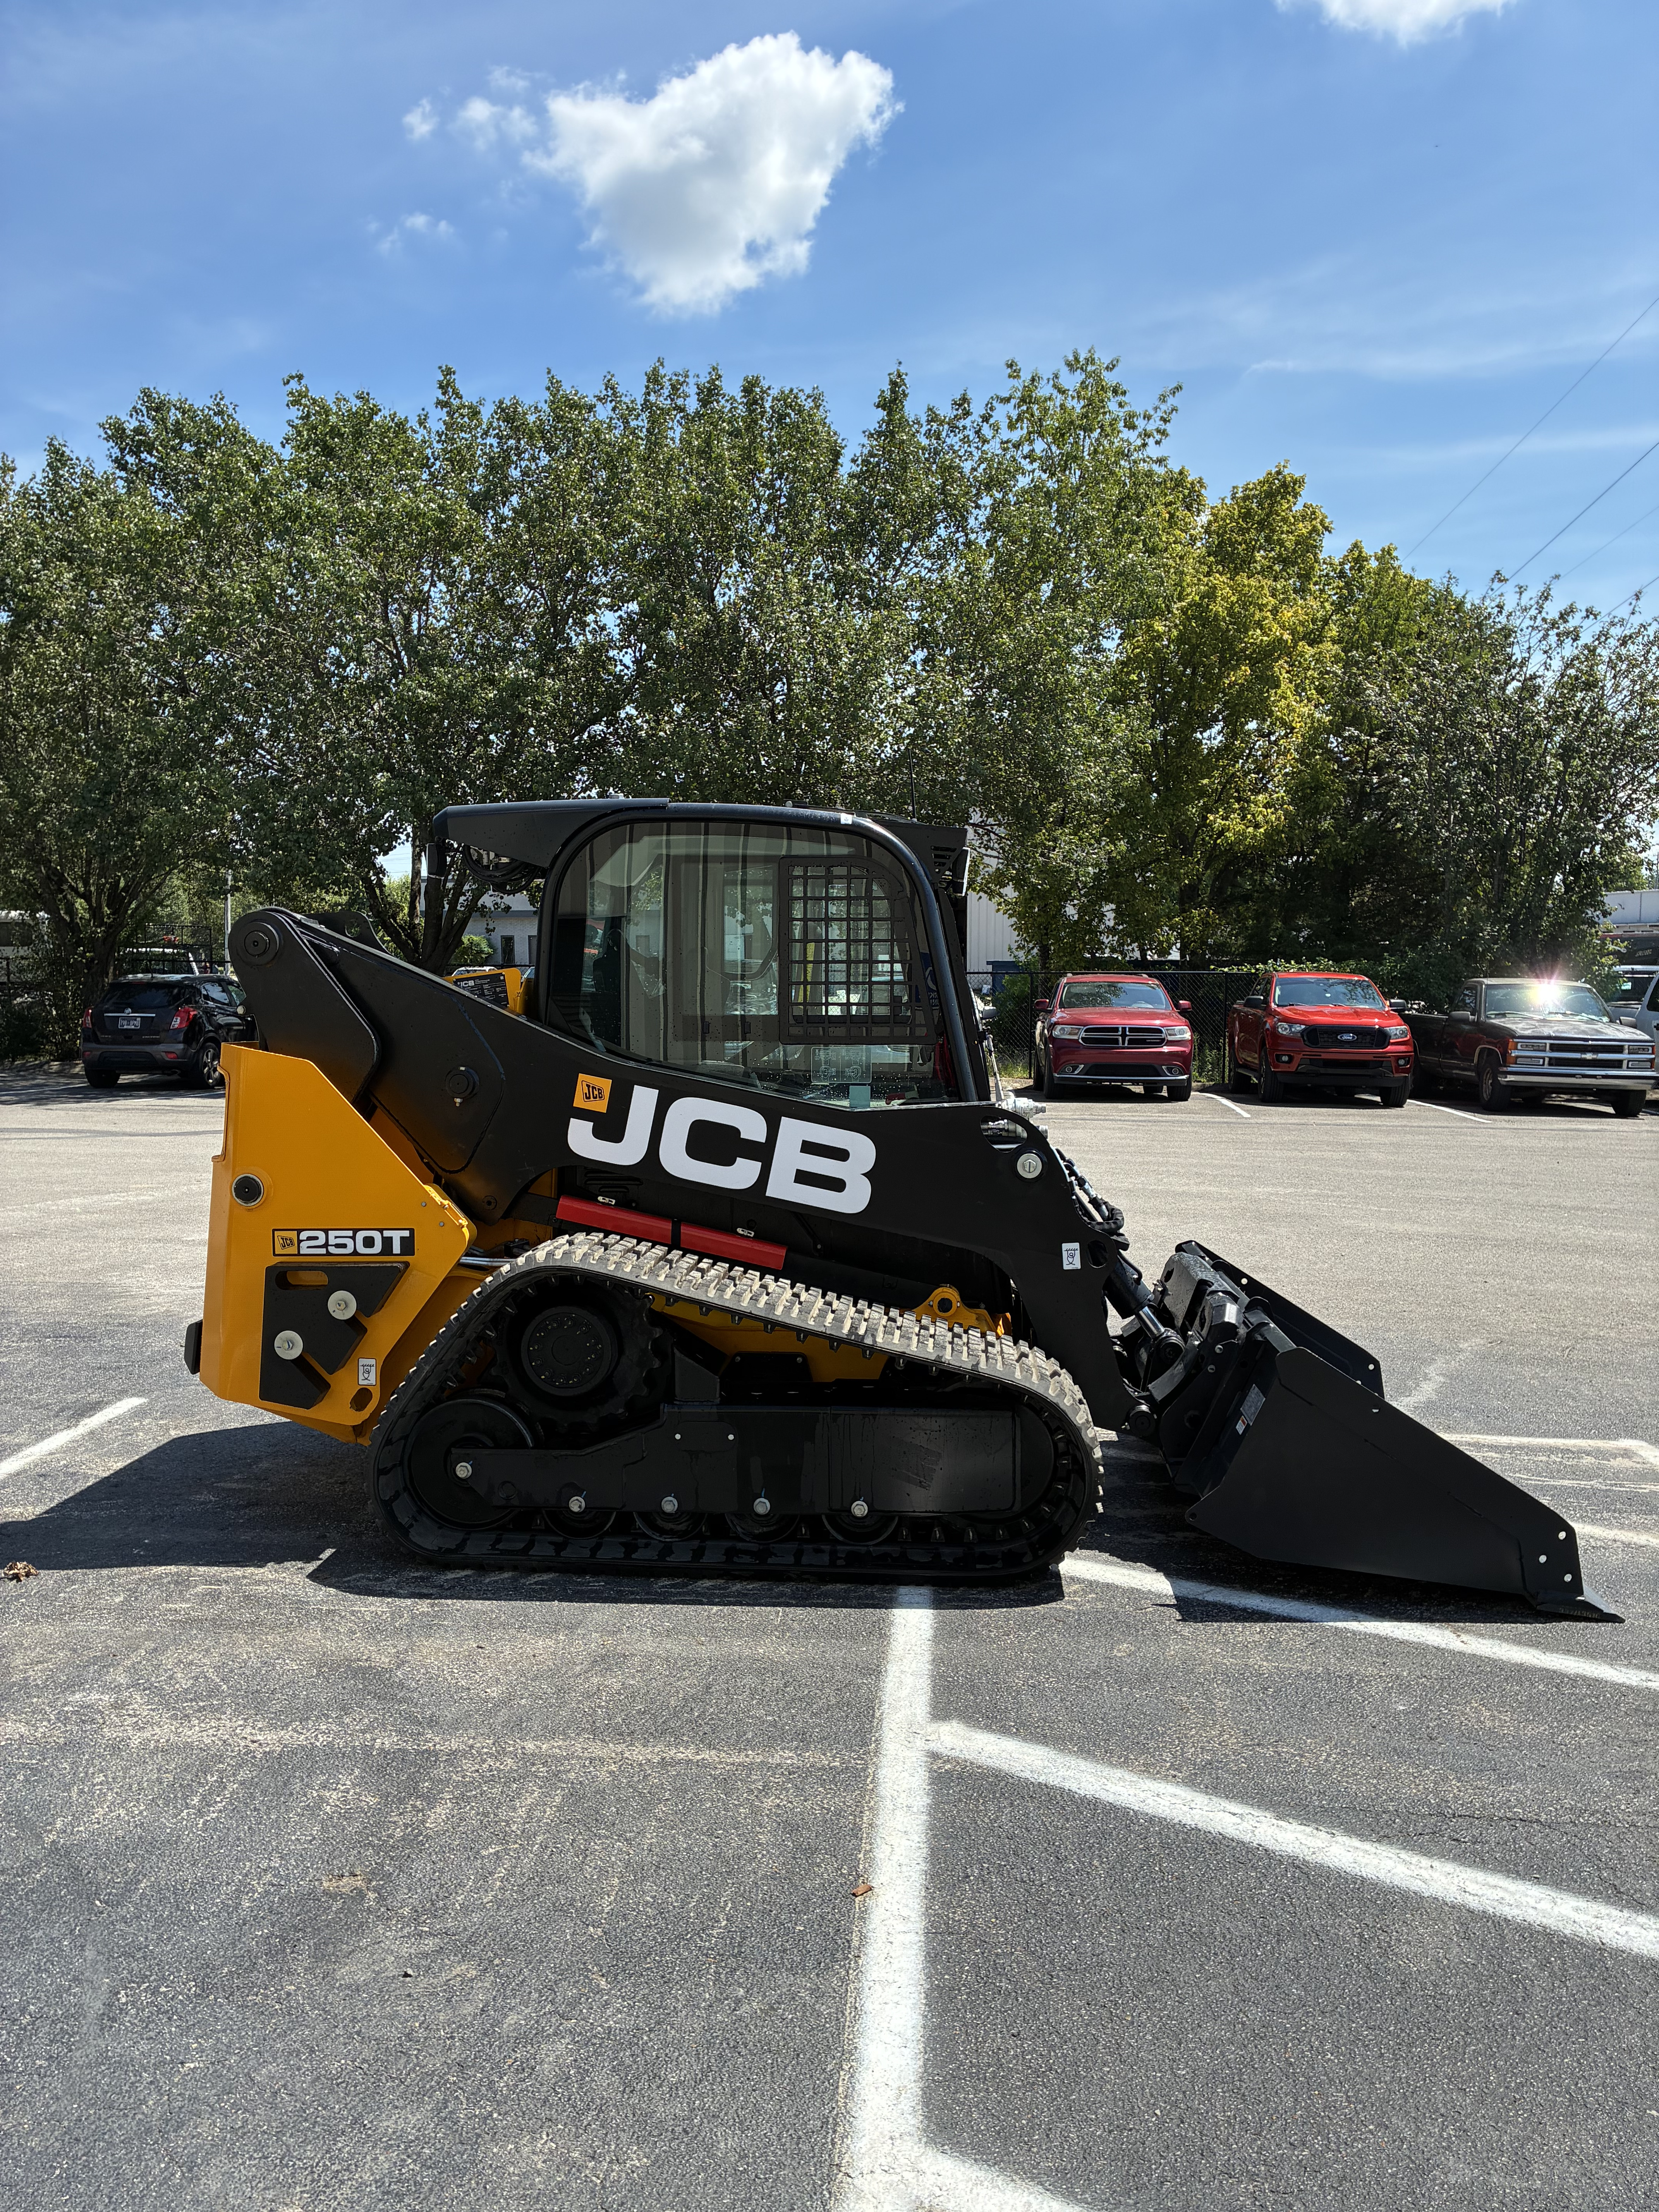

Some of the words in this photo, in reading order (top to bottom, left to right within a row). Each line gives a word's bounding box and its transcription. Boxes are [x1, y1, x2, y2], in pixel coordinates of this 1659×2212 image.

[584, 1083, 603, 1100] JCB
[568, 1085, 876, 1213] JCB
[280, 1237, 294, 1248] JCB
[300, 1230, 409, 1254] 250T
